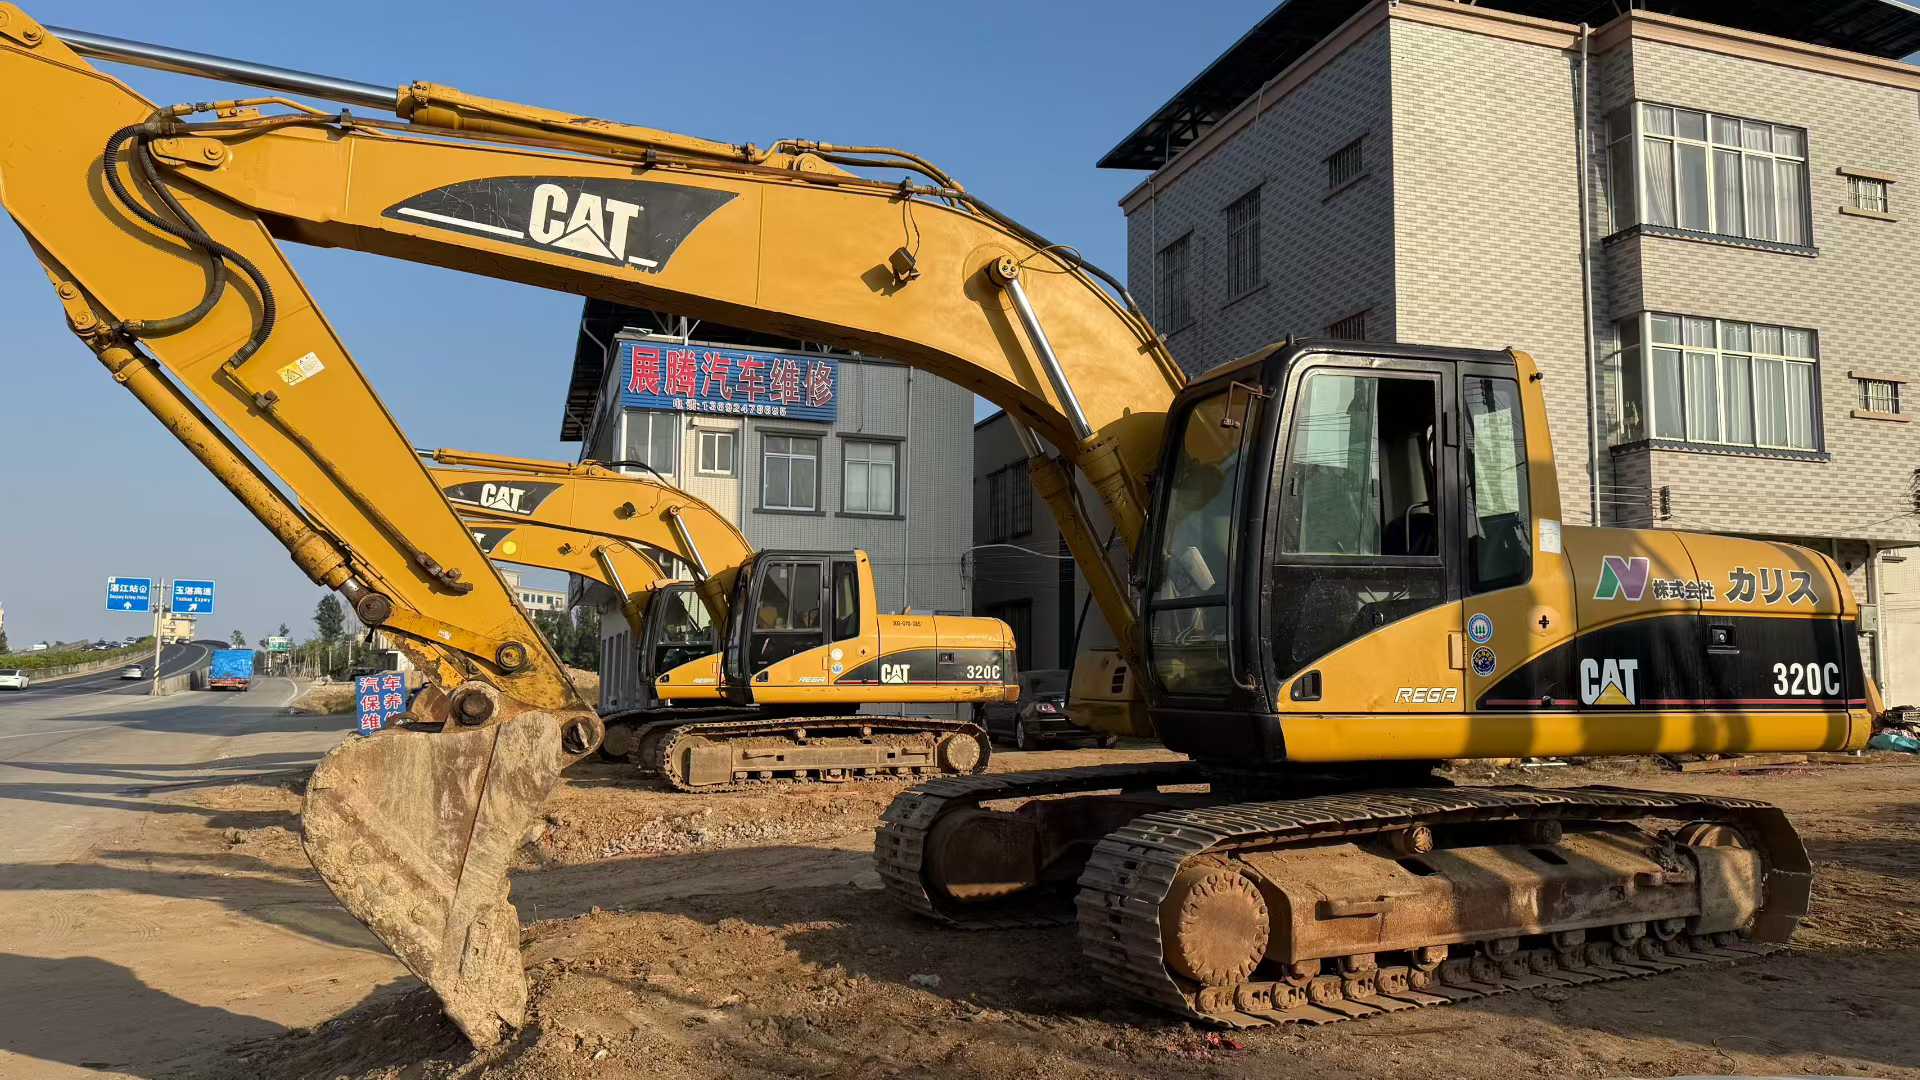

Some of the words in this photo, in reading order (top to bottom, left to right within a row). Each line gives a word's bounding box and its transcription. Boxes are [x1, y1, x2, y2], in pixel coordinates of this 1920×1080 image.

[528, 183, 640, 261] CAT
[628, 346, 833, 407] 展腾汽车维修
[480, 483, 525, 512] CAT
[1652, 578, 1715, 602] 株式会社
[1724, 567, 1820, 607] カリス
[360, 675, 401, 693] 汽车
[881, 664, 910, 684] CAT
[966, 665, 1000, 679] 320C
[1580, 658, 1638, 705] CAT
[1772, 662, 1840, 696] 320C
[360, 693, 402, 712] 保养
[1394, 687, 1458, 703] REGA
